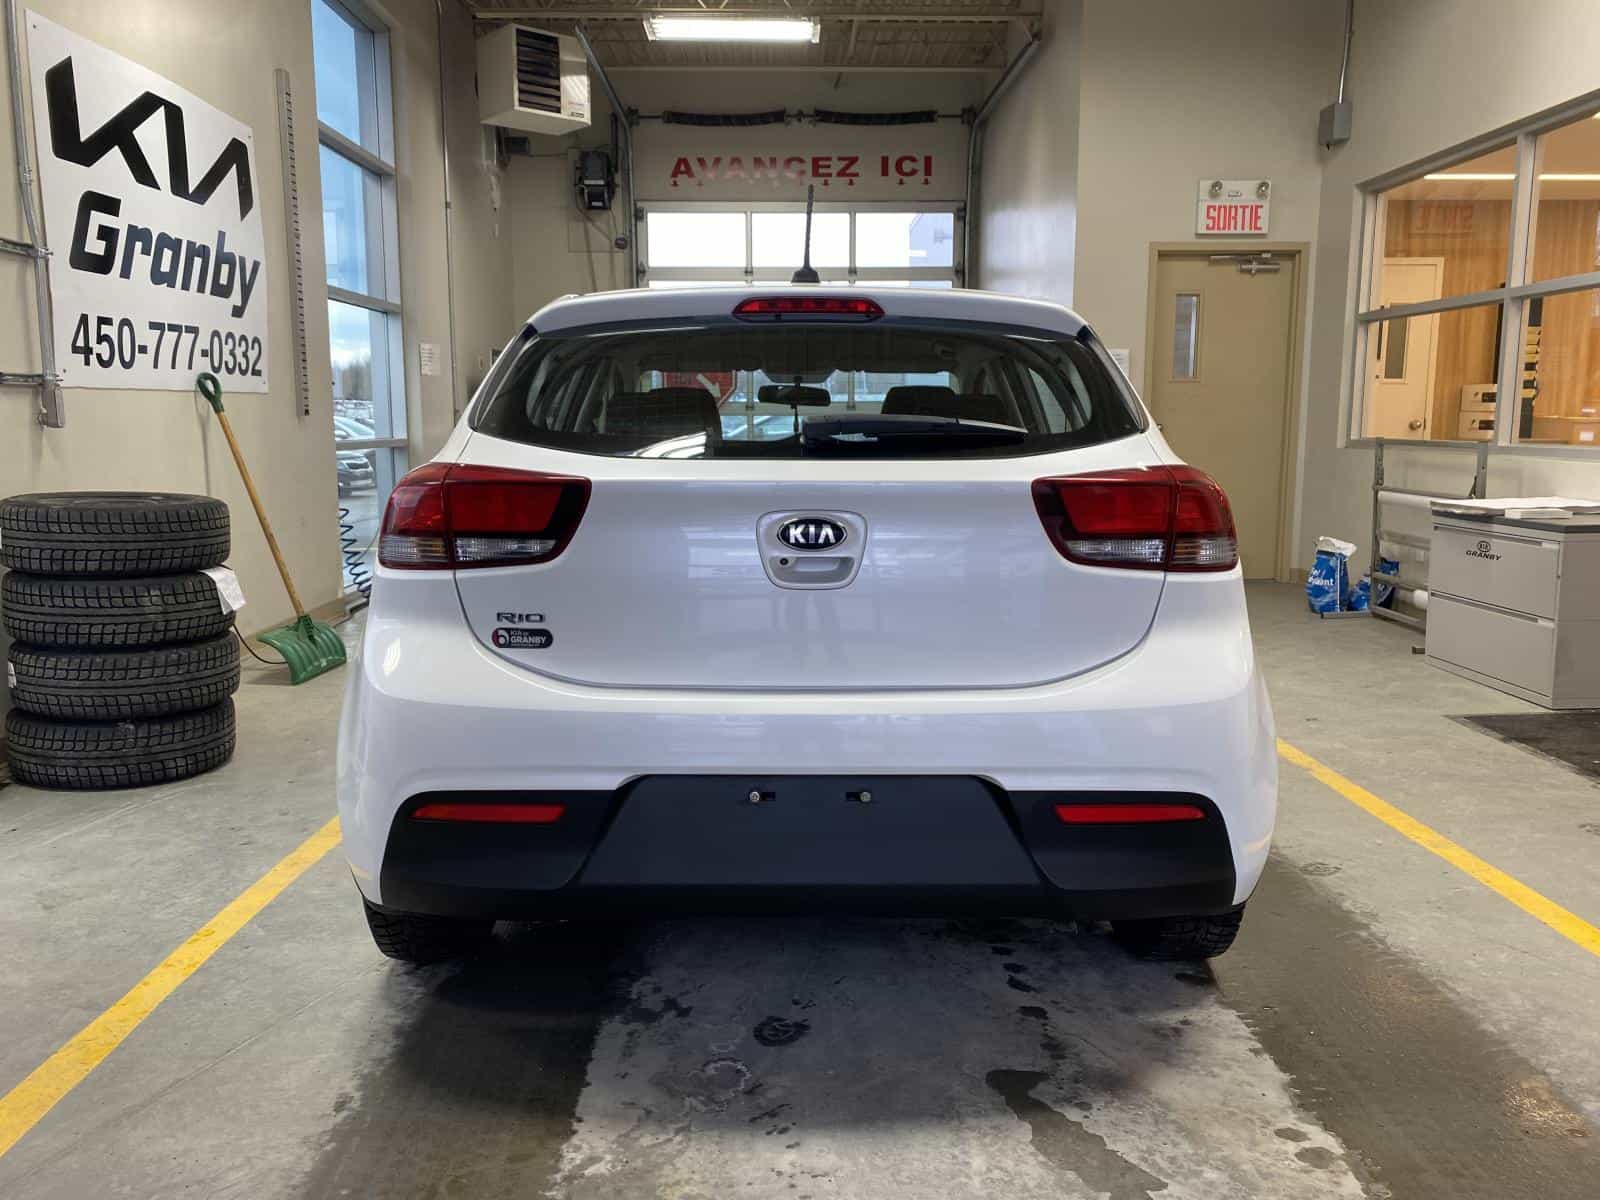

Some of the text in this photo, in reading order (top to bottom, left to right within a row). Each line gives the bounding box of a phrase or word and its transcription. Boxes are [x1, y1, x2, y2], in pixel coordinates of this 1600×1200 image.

[670, 155, 933, 179] AVANCEZ ICI
[1205, 204, 1264, 231] SORTIE
[69, 190, 261, 319] Granby
[71, 313, 262, 377] 450-777-0332
[789, 524, 836, 544] KIA
[1465, 550, 1502, 560] GRANBY
[496, 612, 545, 624] RIO
[511, 636, 547, 644] GRANBY
